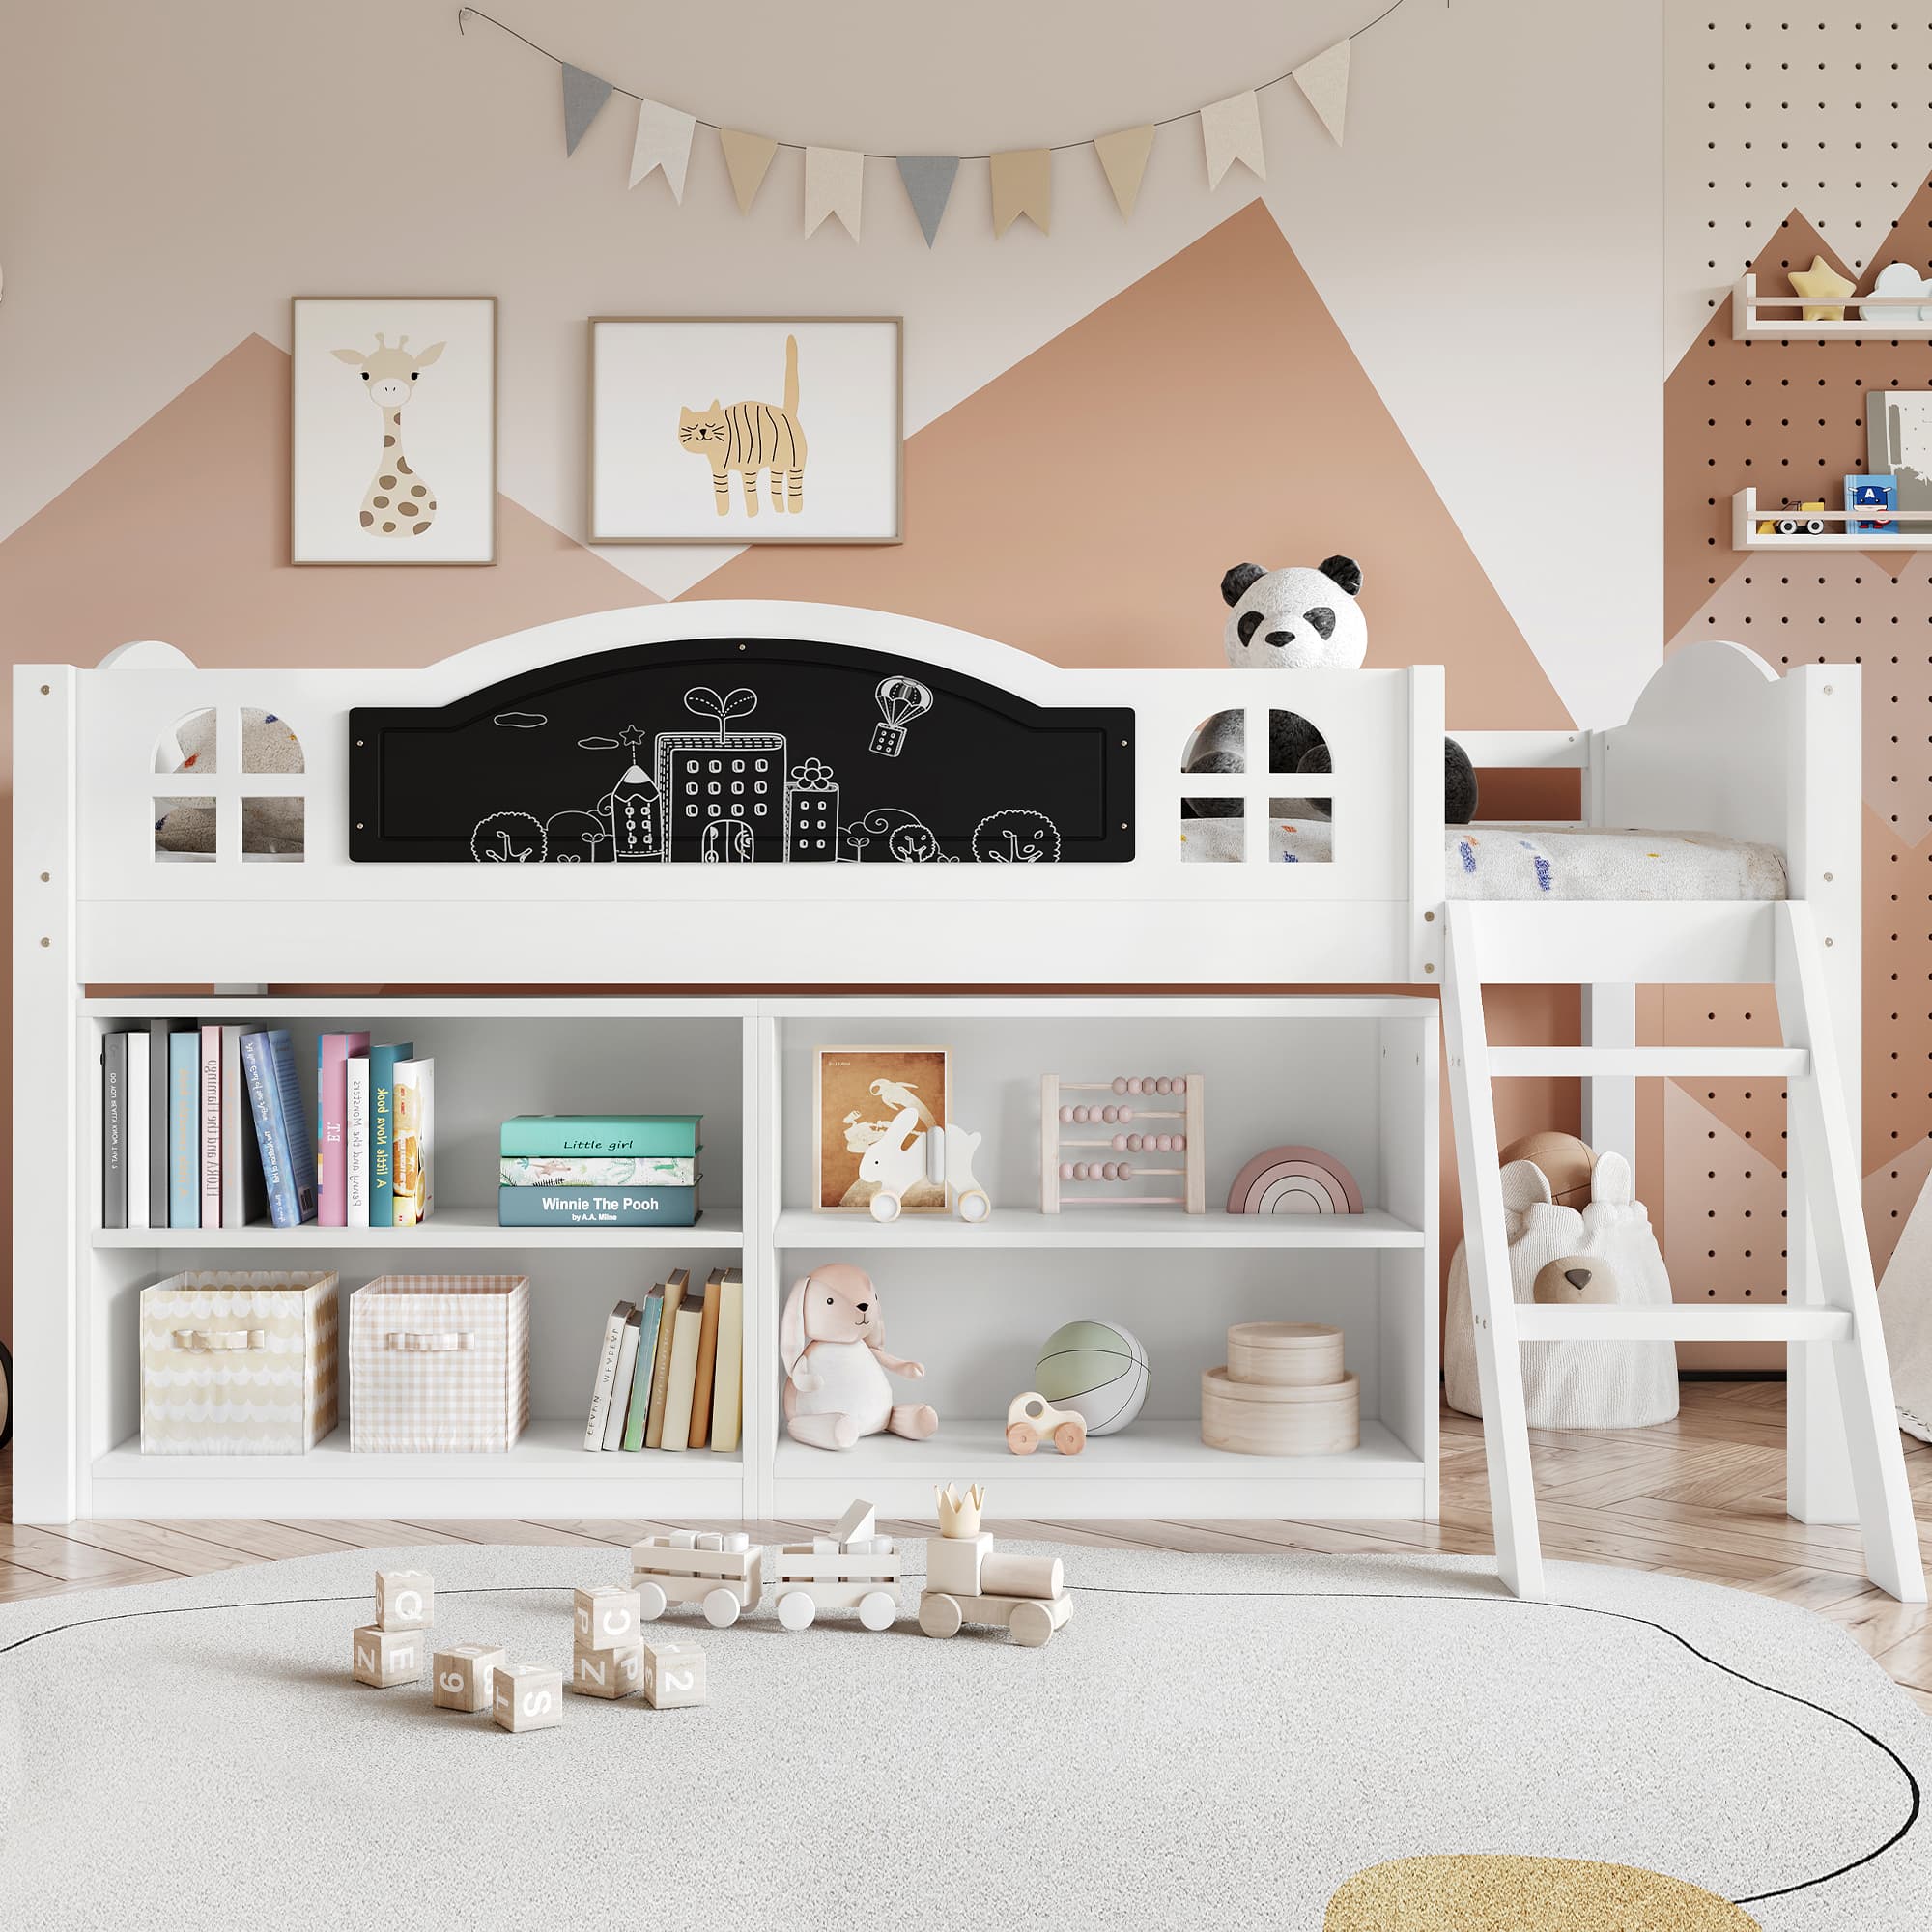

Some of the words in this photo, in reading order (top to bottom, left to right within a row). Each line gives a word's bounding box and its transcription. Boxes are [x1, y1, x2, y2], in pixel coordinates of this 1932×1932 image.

[1865, 488, 1875, 498] A
[564, 1140, 603, 1149] Little
[608, 1140, 633, 1151] girl
[542, 1198, 589, 1210] Winnie
[593, 1198, 619, 1210] The
[623, 1198, 659, 1210] Pooh
[572, 1213, 582, 1222] by
[395, 1590, 423, 1621] Q
[577, 1607, 588, 1634] P
[603, 1609, 631, 1635] C
[389, 1646, 414, 1673] E
[621, 1656, 639, 1681] P
[665, 1670, 694, 1692] 2
[496, 1685, 509, 1710] T
[523, 1690, 552, 1717] S
